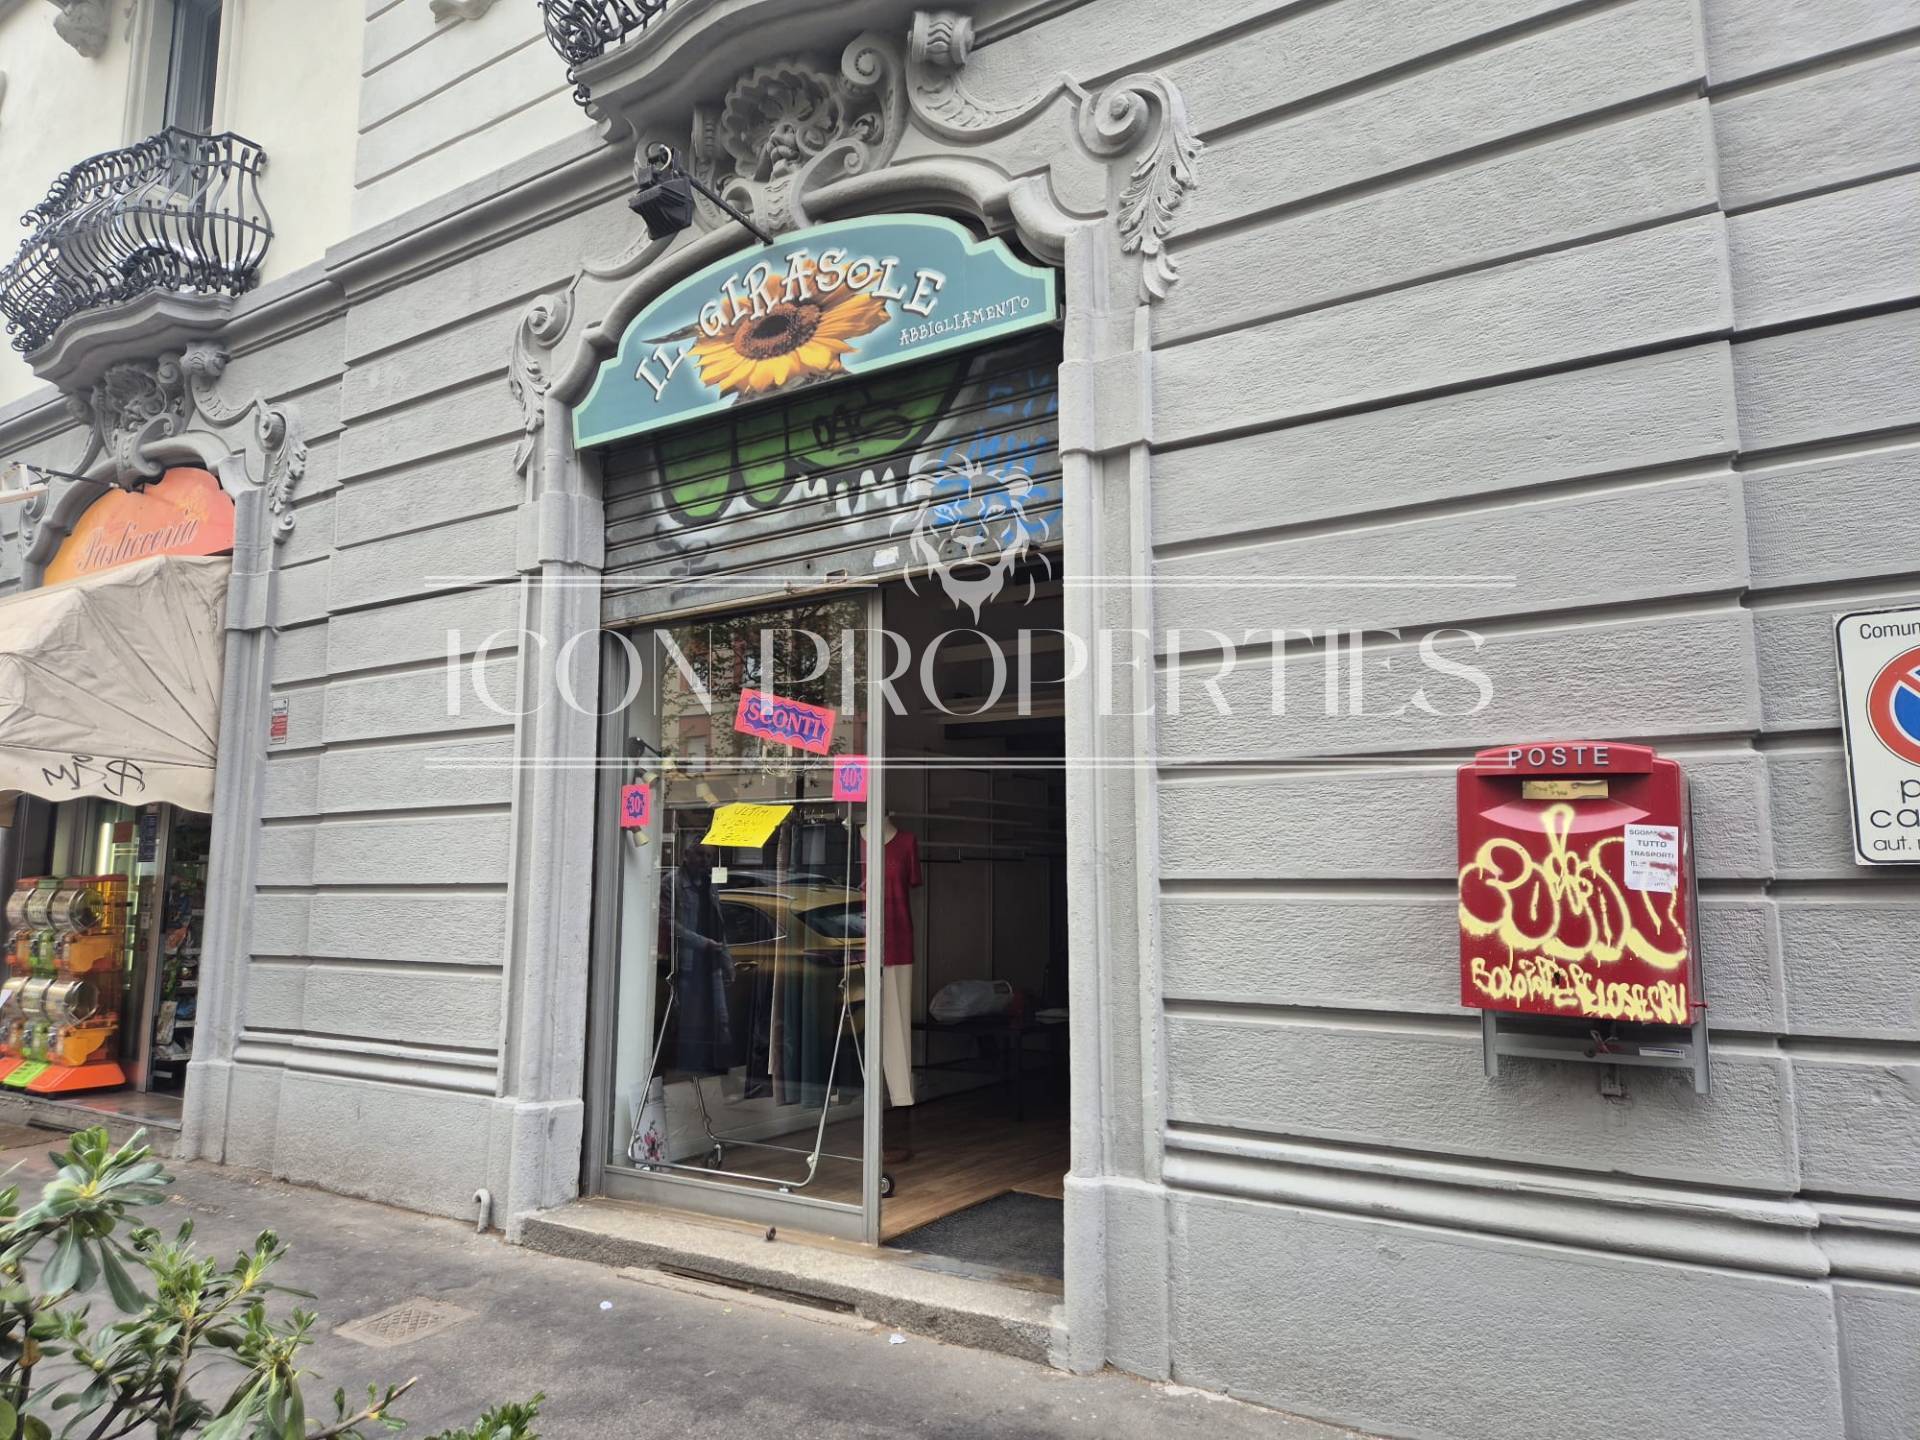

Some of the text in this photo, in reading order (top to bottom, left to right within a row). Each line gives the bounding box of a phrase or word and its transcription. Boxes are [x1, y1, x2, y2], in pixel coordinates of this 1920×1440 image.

[634, 246, 946, 402] IL GIRASOLE
[898, 294, 1031, 347] ABBIGLIAMENTO
[78, 511, 200, 571] Pasticceria
[746, 699, 823, 743] SCONTI
[1507, 746, 1610, 769] POSTE
[1630, 850, 1675, 859] TRASPORTI
[1637, 839, 1668, 848] TUTTO
[1873, 836, 1912, 851] aut.
